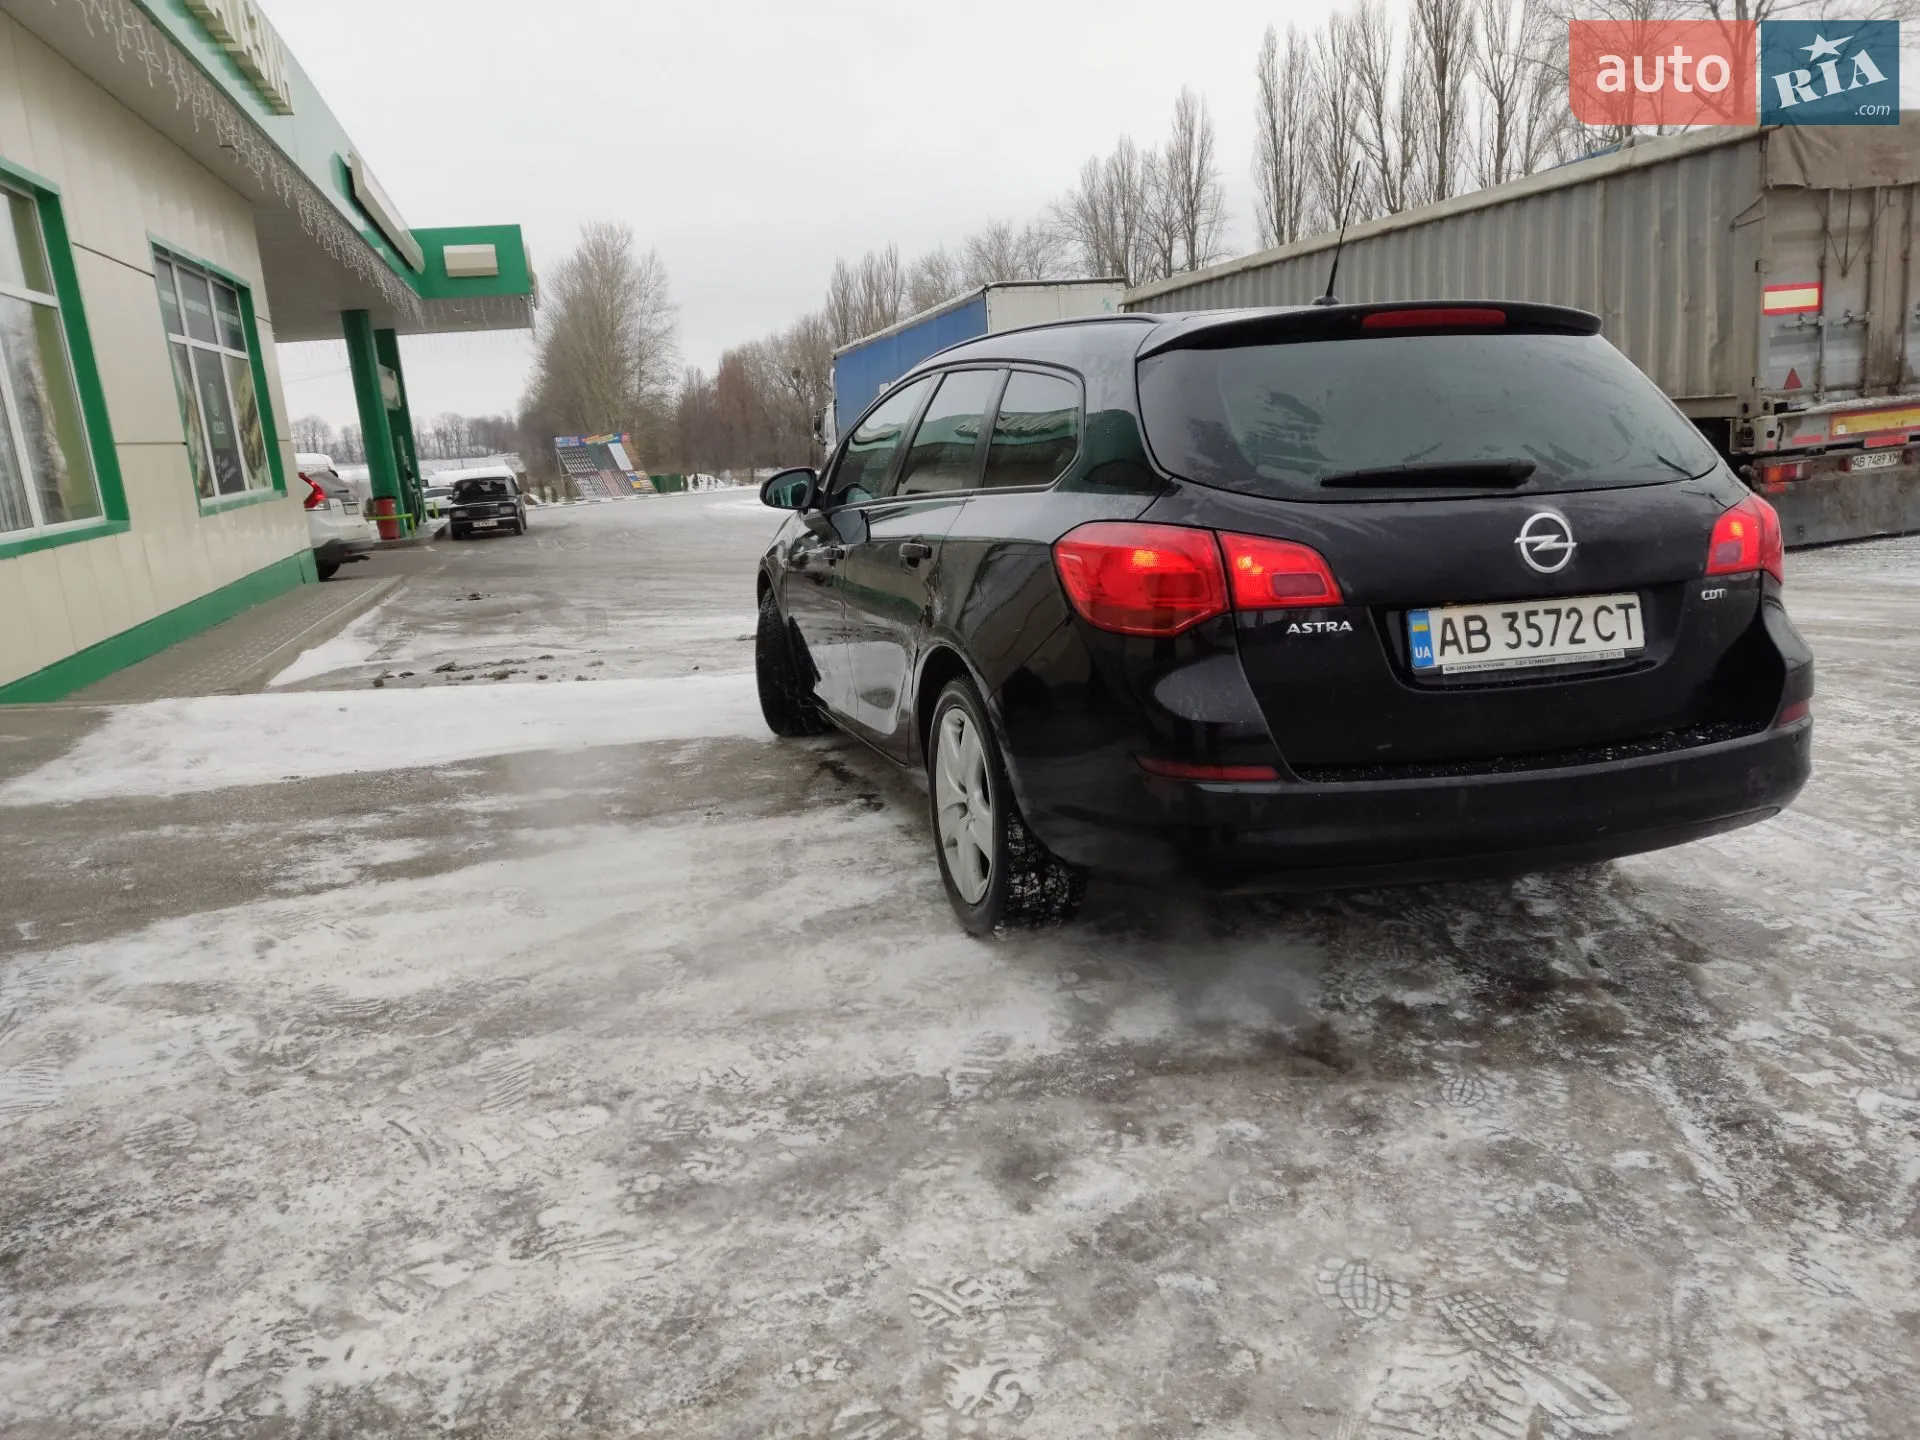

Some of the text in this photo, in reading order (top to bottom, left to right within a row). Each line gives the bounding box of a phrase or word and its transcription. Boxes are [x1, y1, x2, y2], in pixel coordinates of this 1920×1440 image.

[1286, 621, 1353, 634] ASTRA
[1439, 602, 1637, 656] AB 3572 CT
[1414, 646, 1431, 659] UA
